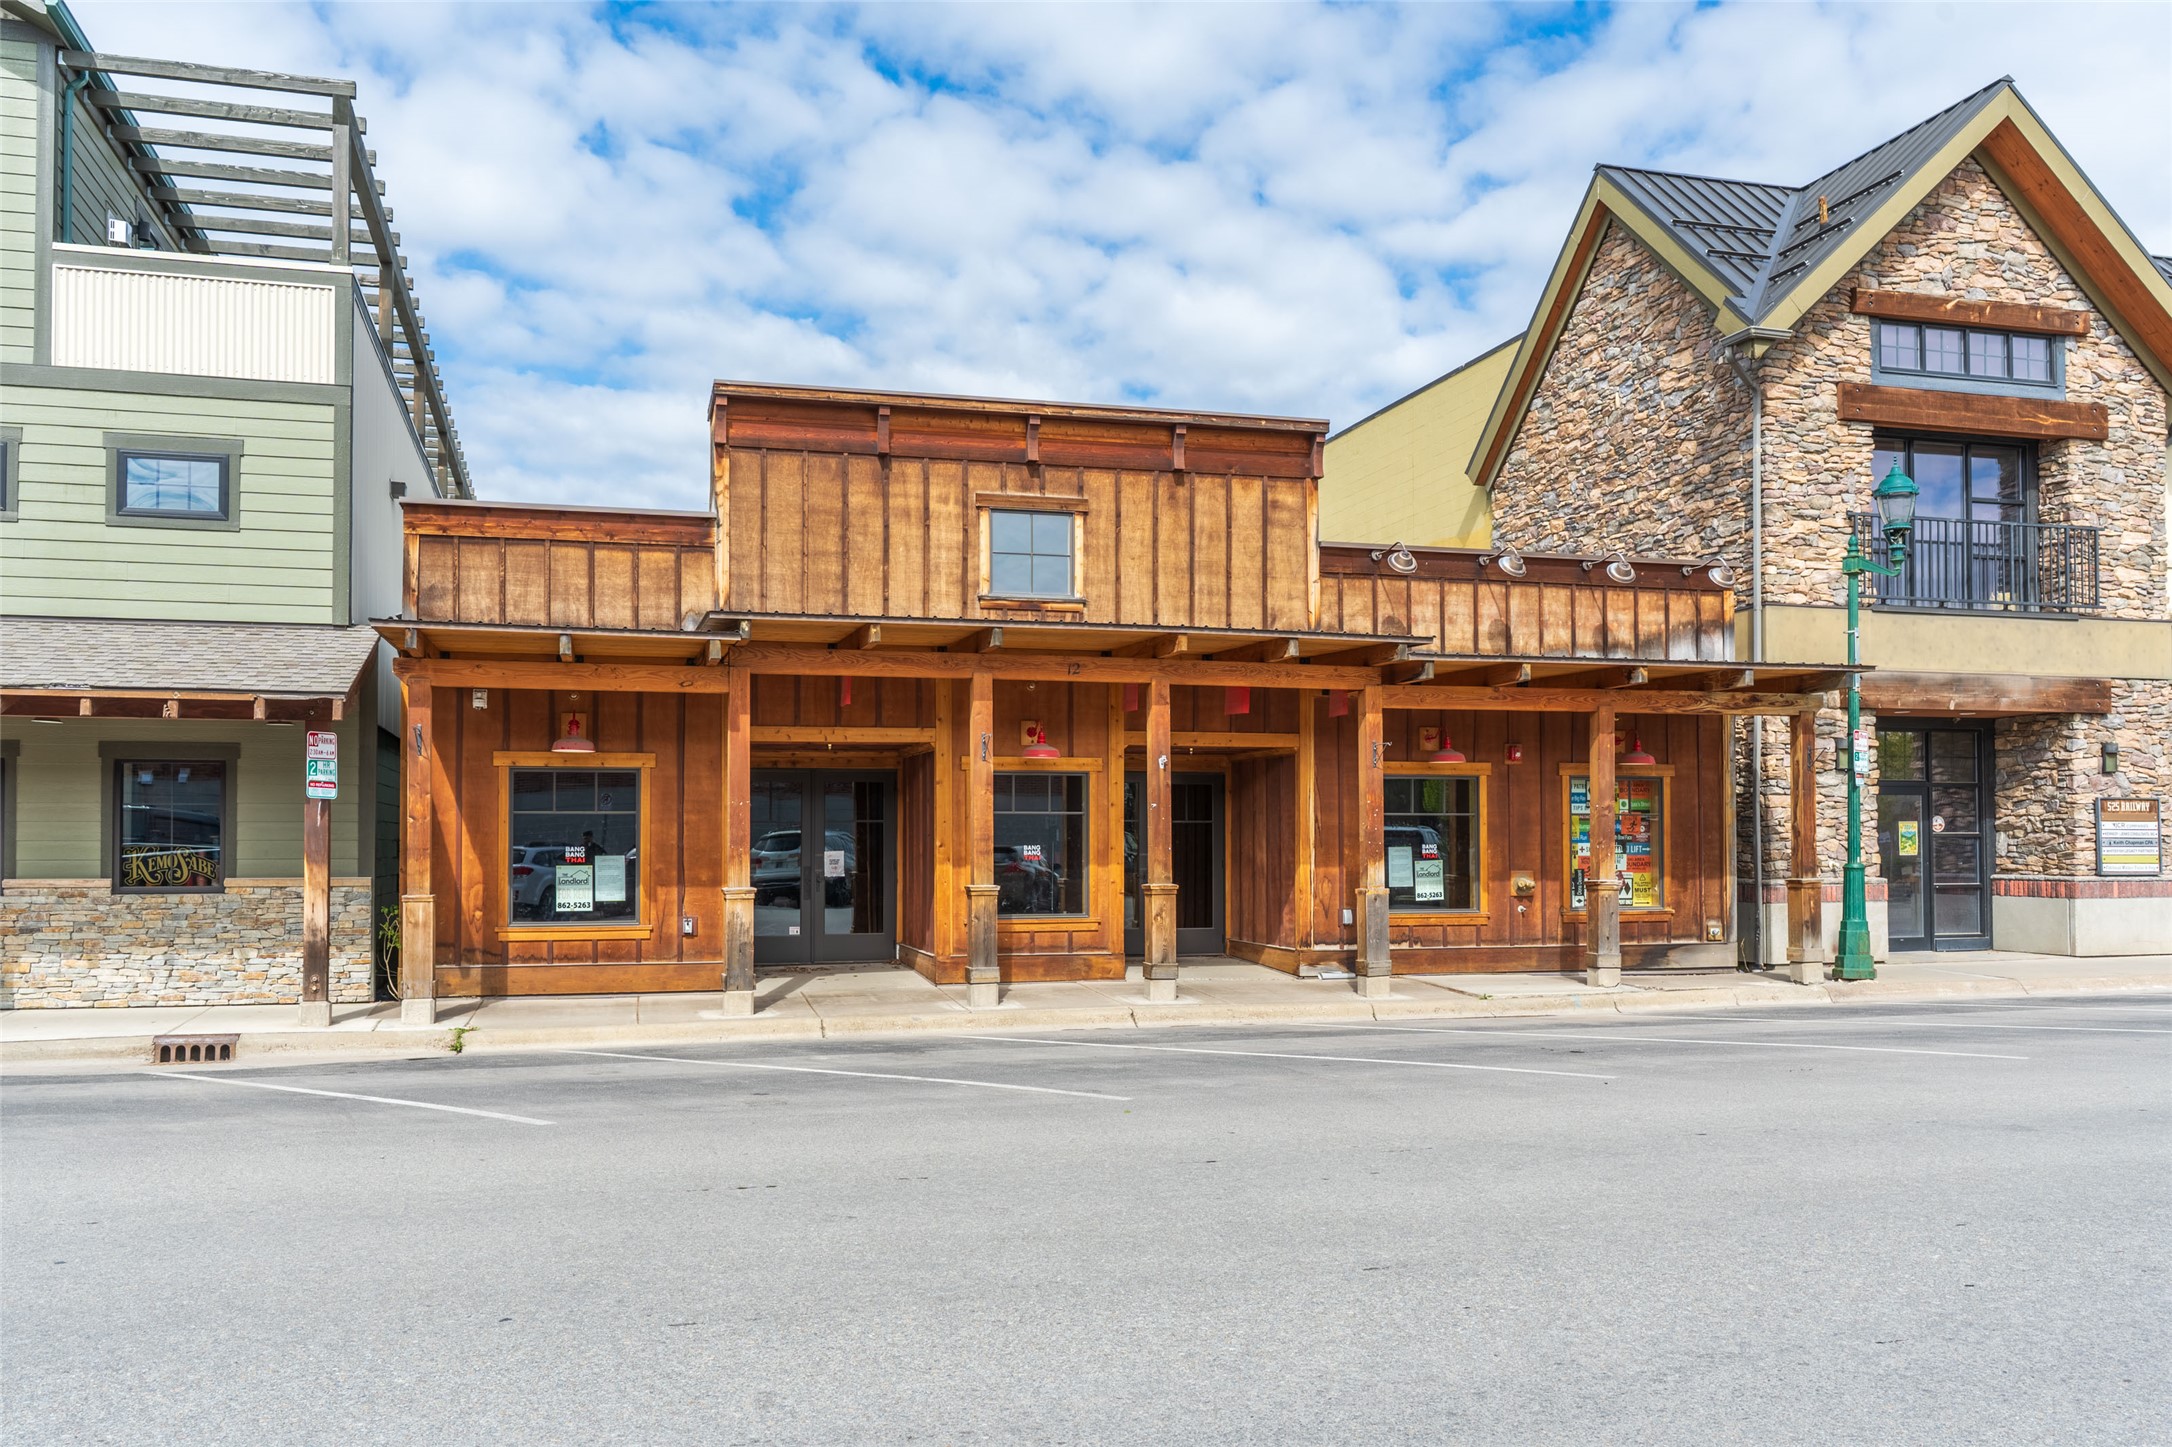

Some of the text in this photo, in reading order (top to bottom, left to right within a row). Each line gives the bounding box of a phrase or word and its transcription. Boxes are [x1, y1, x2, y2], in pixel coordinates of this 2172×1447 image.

[309, 734, 335, 746] NO PARKING
[310, 762, 316, 776] 2
[2108, 802, 2150, 812] 525 RAILWAY
